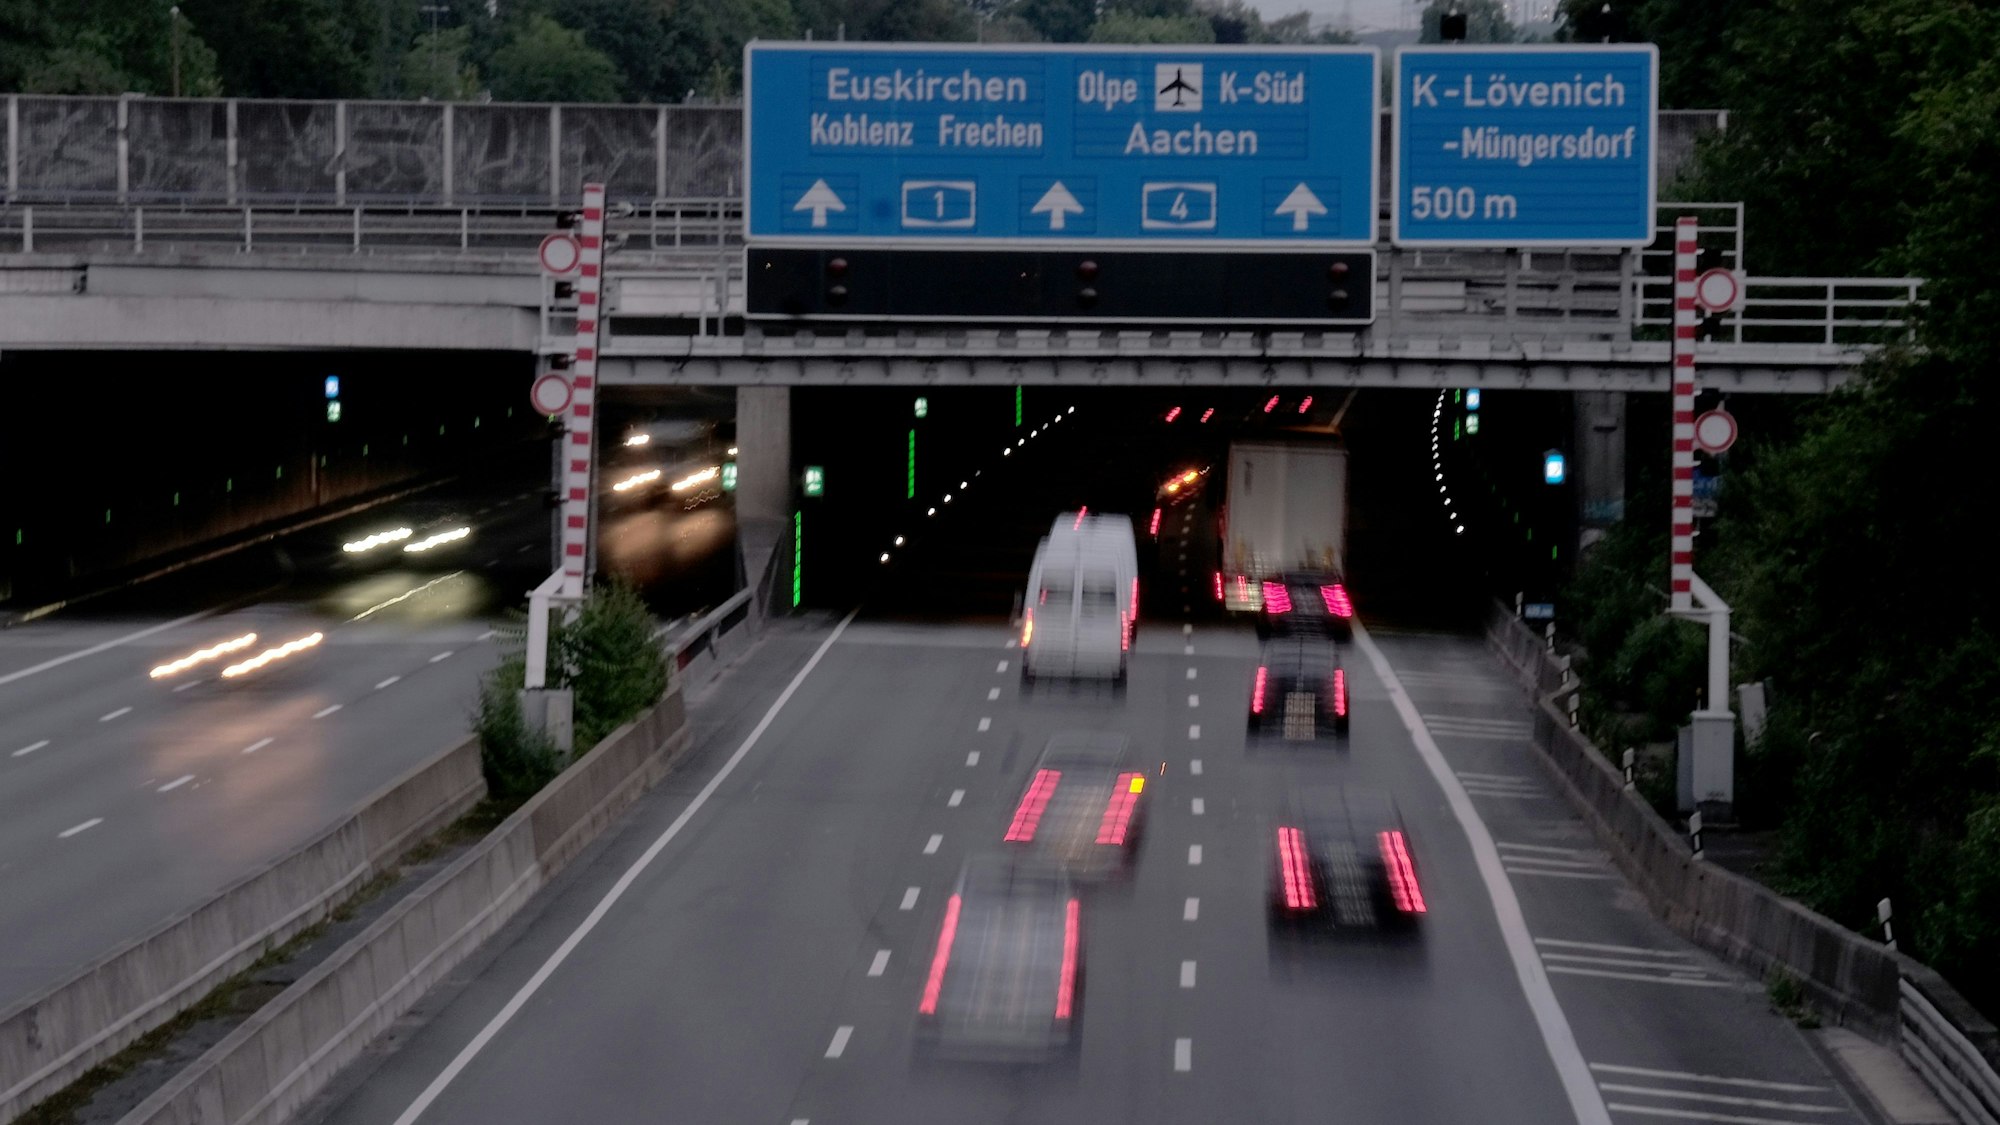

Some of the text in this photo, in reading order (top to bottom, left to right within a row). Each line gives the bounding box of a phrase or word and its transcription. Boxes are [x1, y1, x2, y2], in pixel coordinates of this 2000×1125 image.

[828, 68, 1027, 102] Euskirchen
[1078, 71, 1305, 111] Olpe K-Süd
[1412, 74, 1625, 107] K-Lövenich
[811, 113, 1044, 148] Koblenz Frechen
[1125, 122, 1258, 155] Aachen
[1443, 126, 1635, 166] -Müngersdorf
[933, 190, 944, 218] 1
[1170, 192, 1189, 220] 4
[1412, 186, 1518, 219] 500 m
